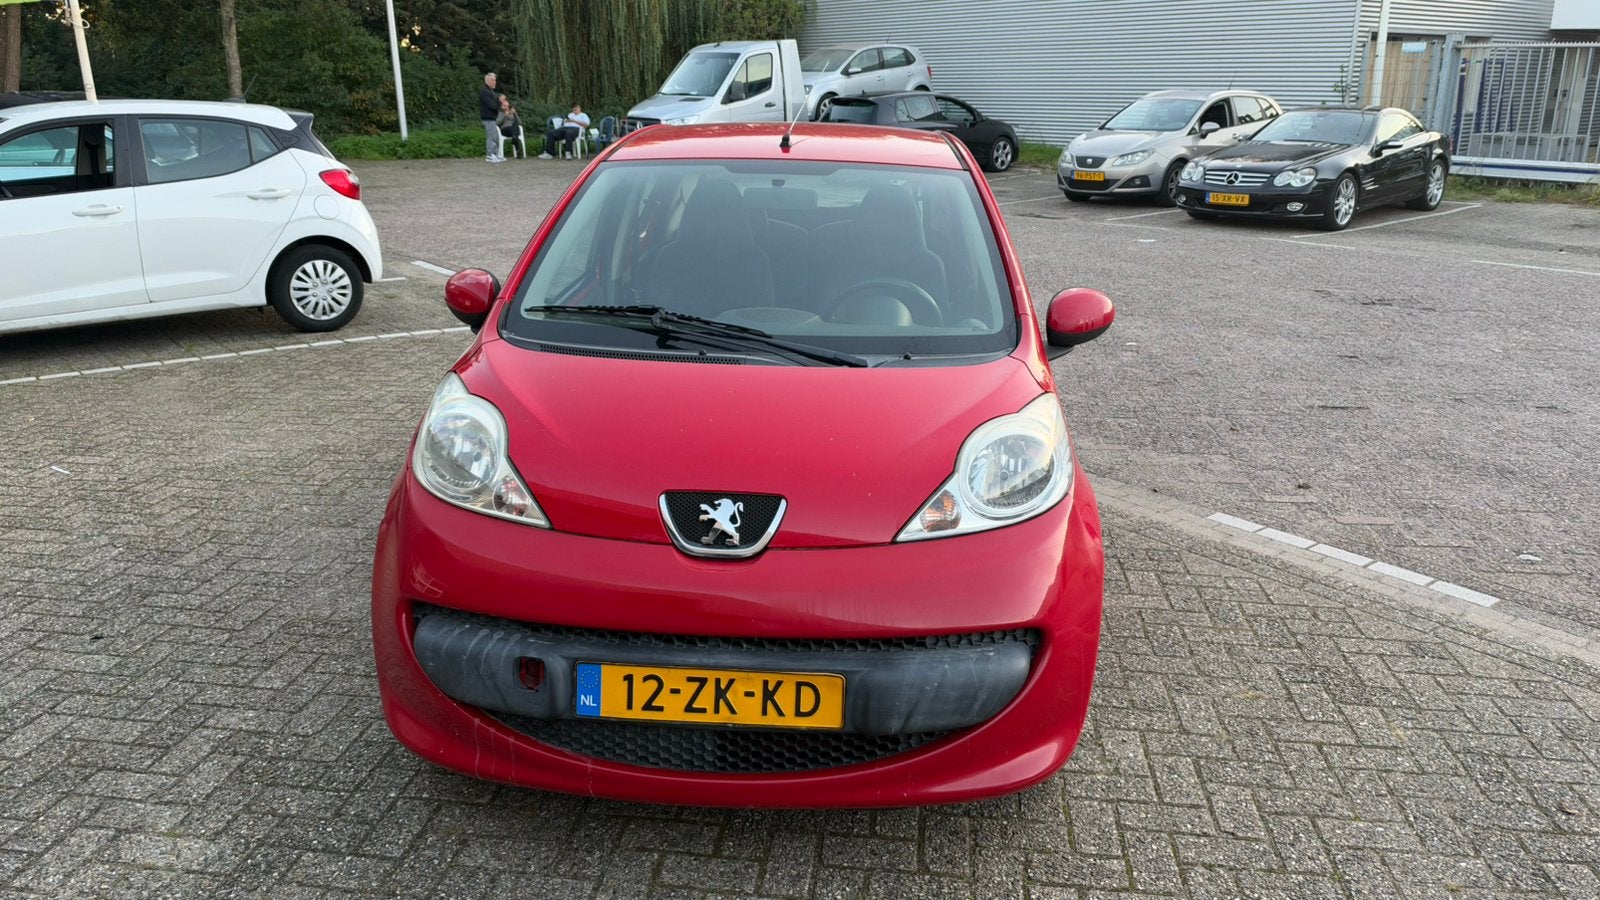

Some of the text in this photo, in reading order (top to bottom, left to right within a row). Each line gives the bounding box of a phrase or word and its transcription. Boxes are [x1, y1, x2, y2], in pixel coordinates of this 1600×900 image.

[1212, 193, 1246, 203] 15-XR-VX
[580, 694, 597, 707] NL
[622, 673, 821, 718] 12-ZK-KD
